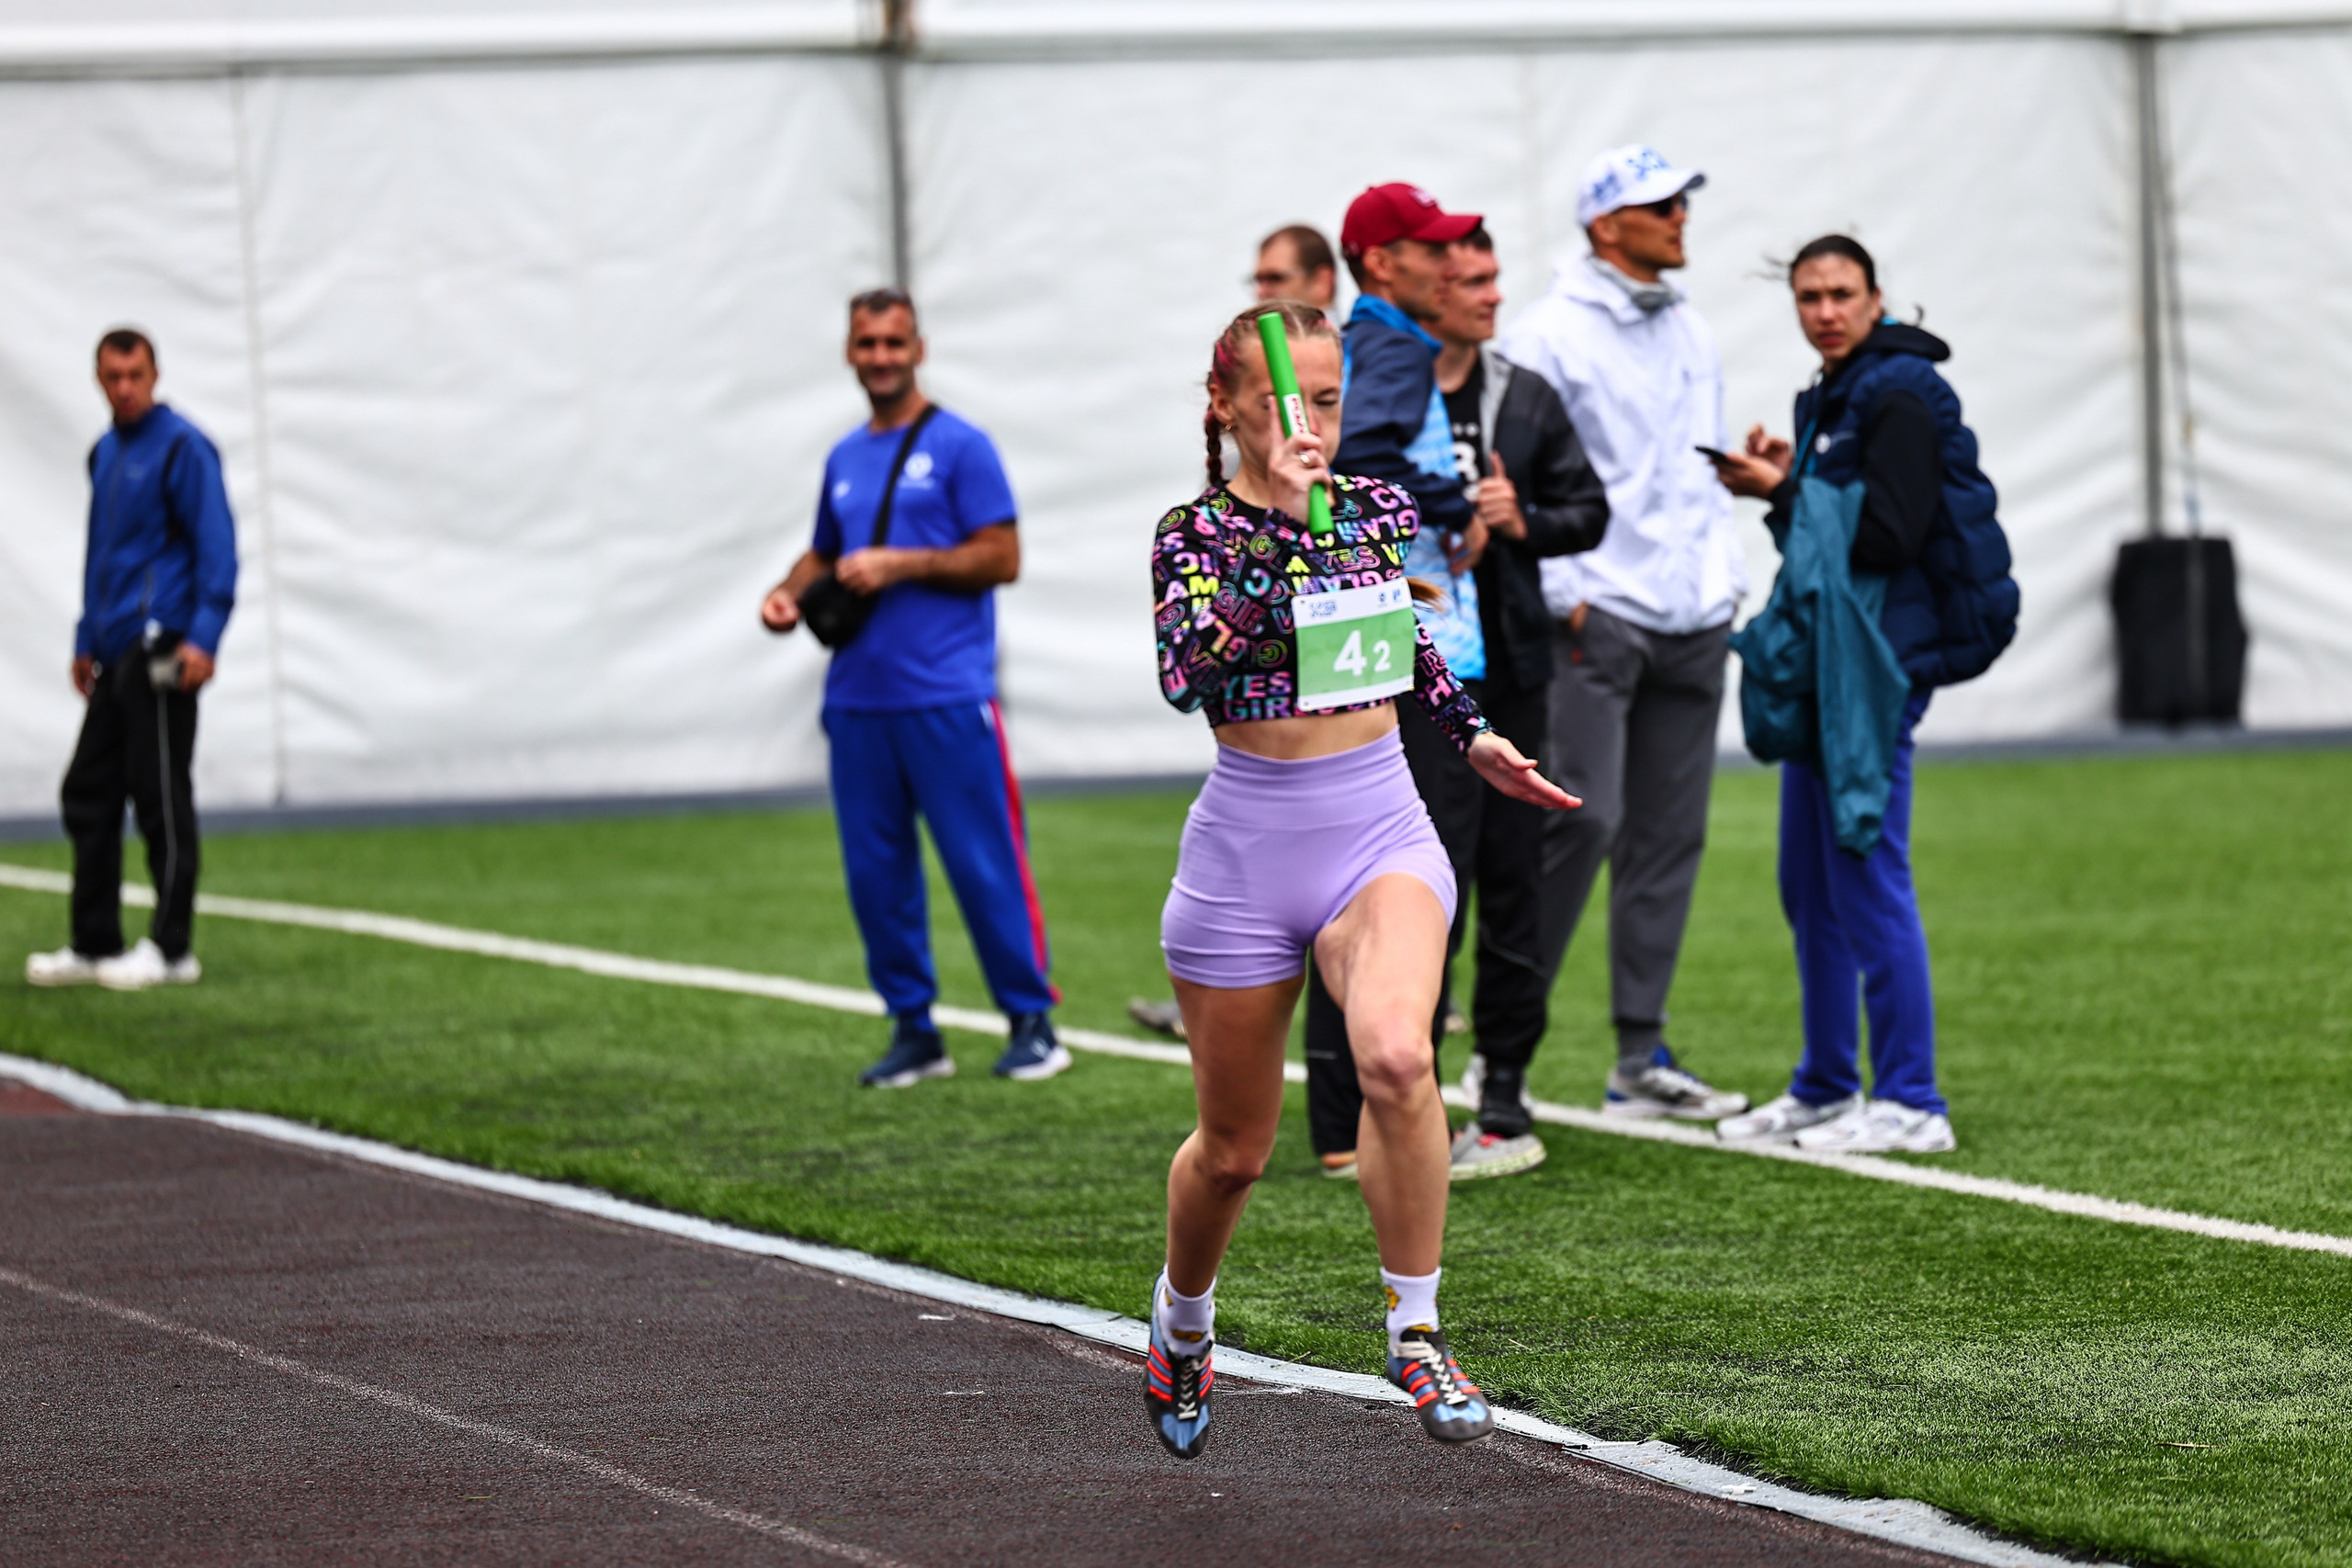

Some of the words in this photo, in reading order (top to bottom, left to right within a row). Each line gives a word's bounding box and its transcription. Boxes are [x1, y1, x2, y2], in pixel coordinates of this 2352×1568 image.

[1333, 629, 1368, 677] 4
[1373, 639, 1392, 672] 2
[1224, 671, 1293, 702] YES
